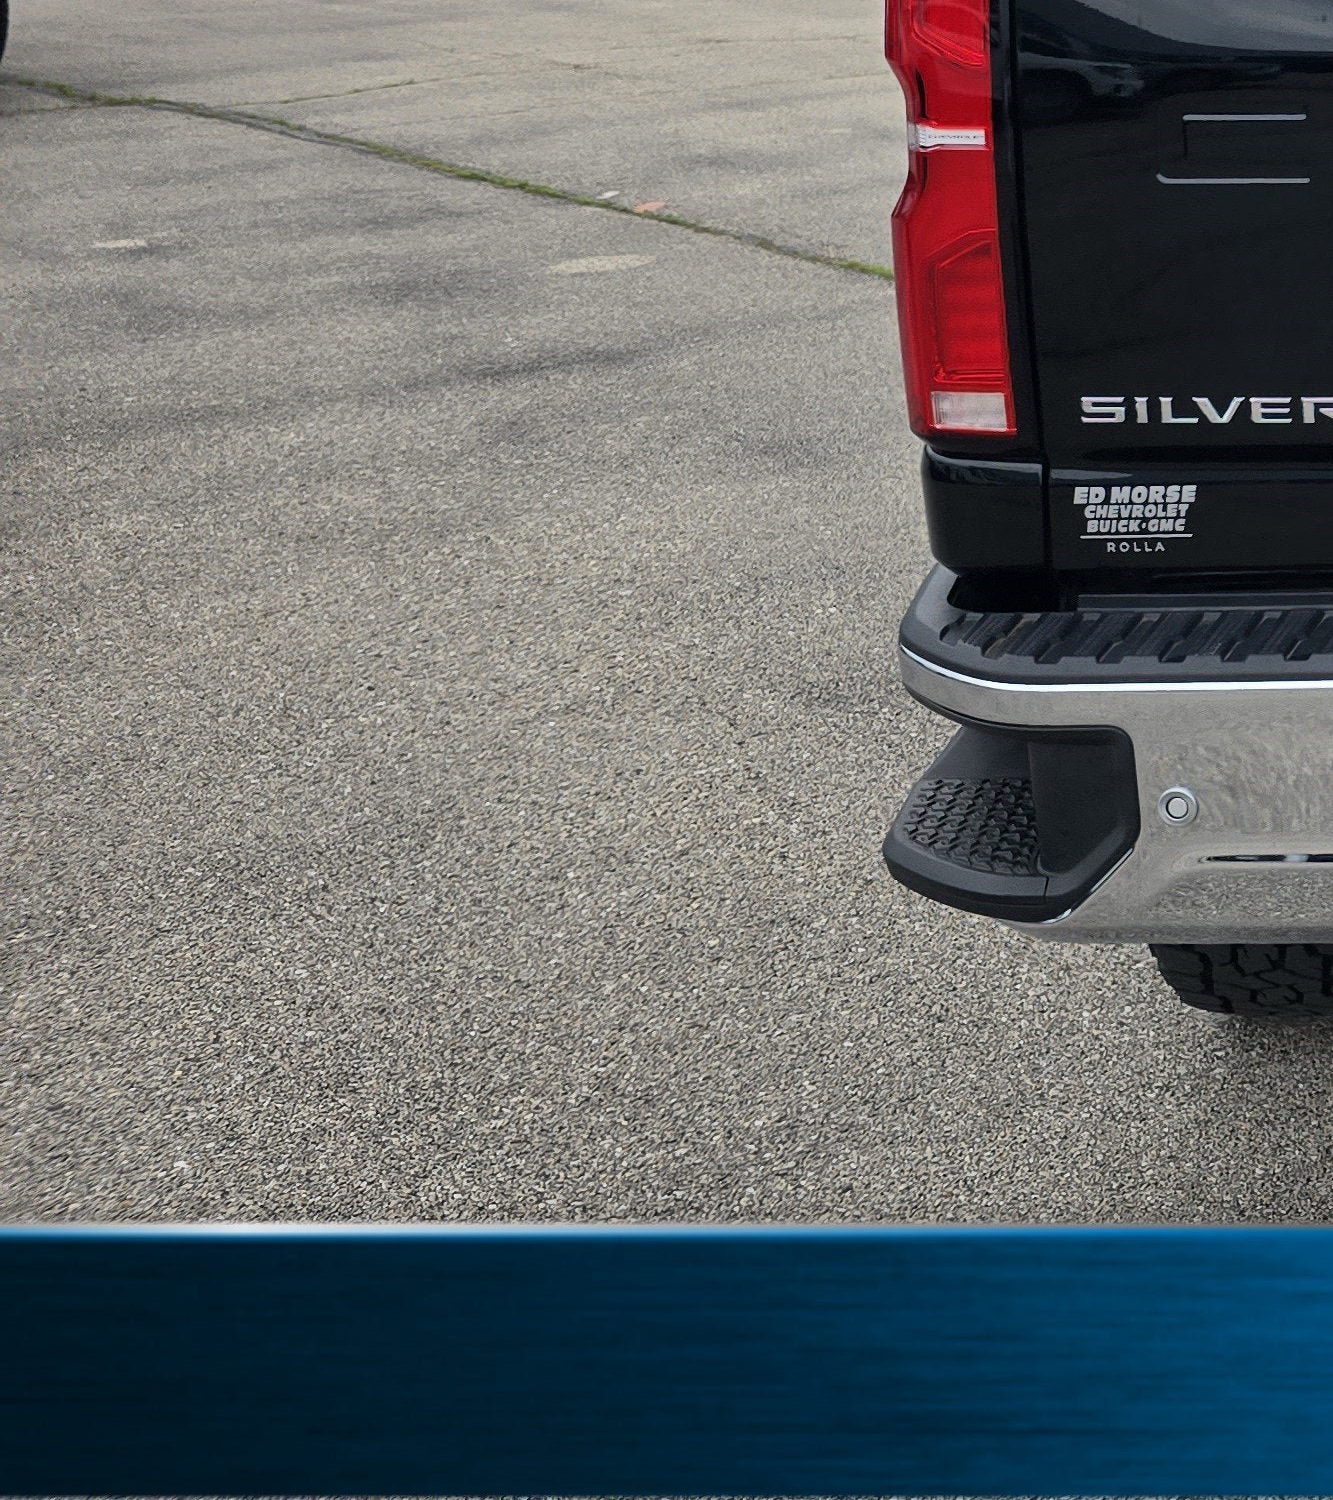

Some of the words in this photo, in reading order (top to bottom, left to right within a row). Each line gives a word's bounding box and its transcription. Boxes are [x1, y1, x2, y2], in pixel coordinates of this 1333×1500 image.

[1073, 486, 1106, 505] ED
[1110, 485, 1198, 504] MORSE
[1084, 503, 1190, 519] CHEVROLET
[1106, 541, 1166, 553] ROLLA
